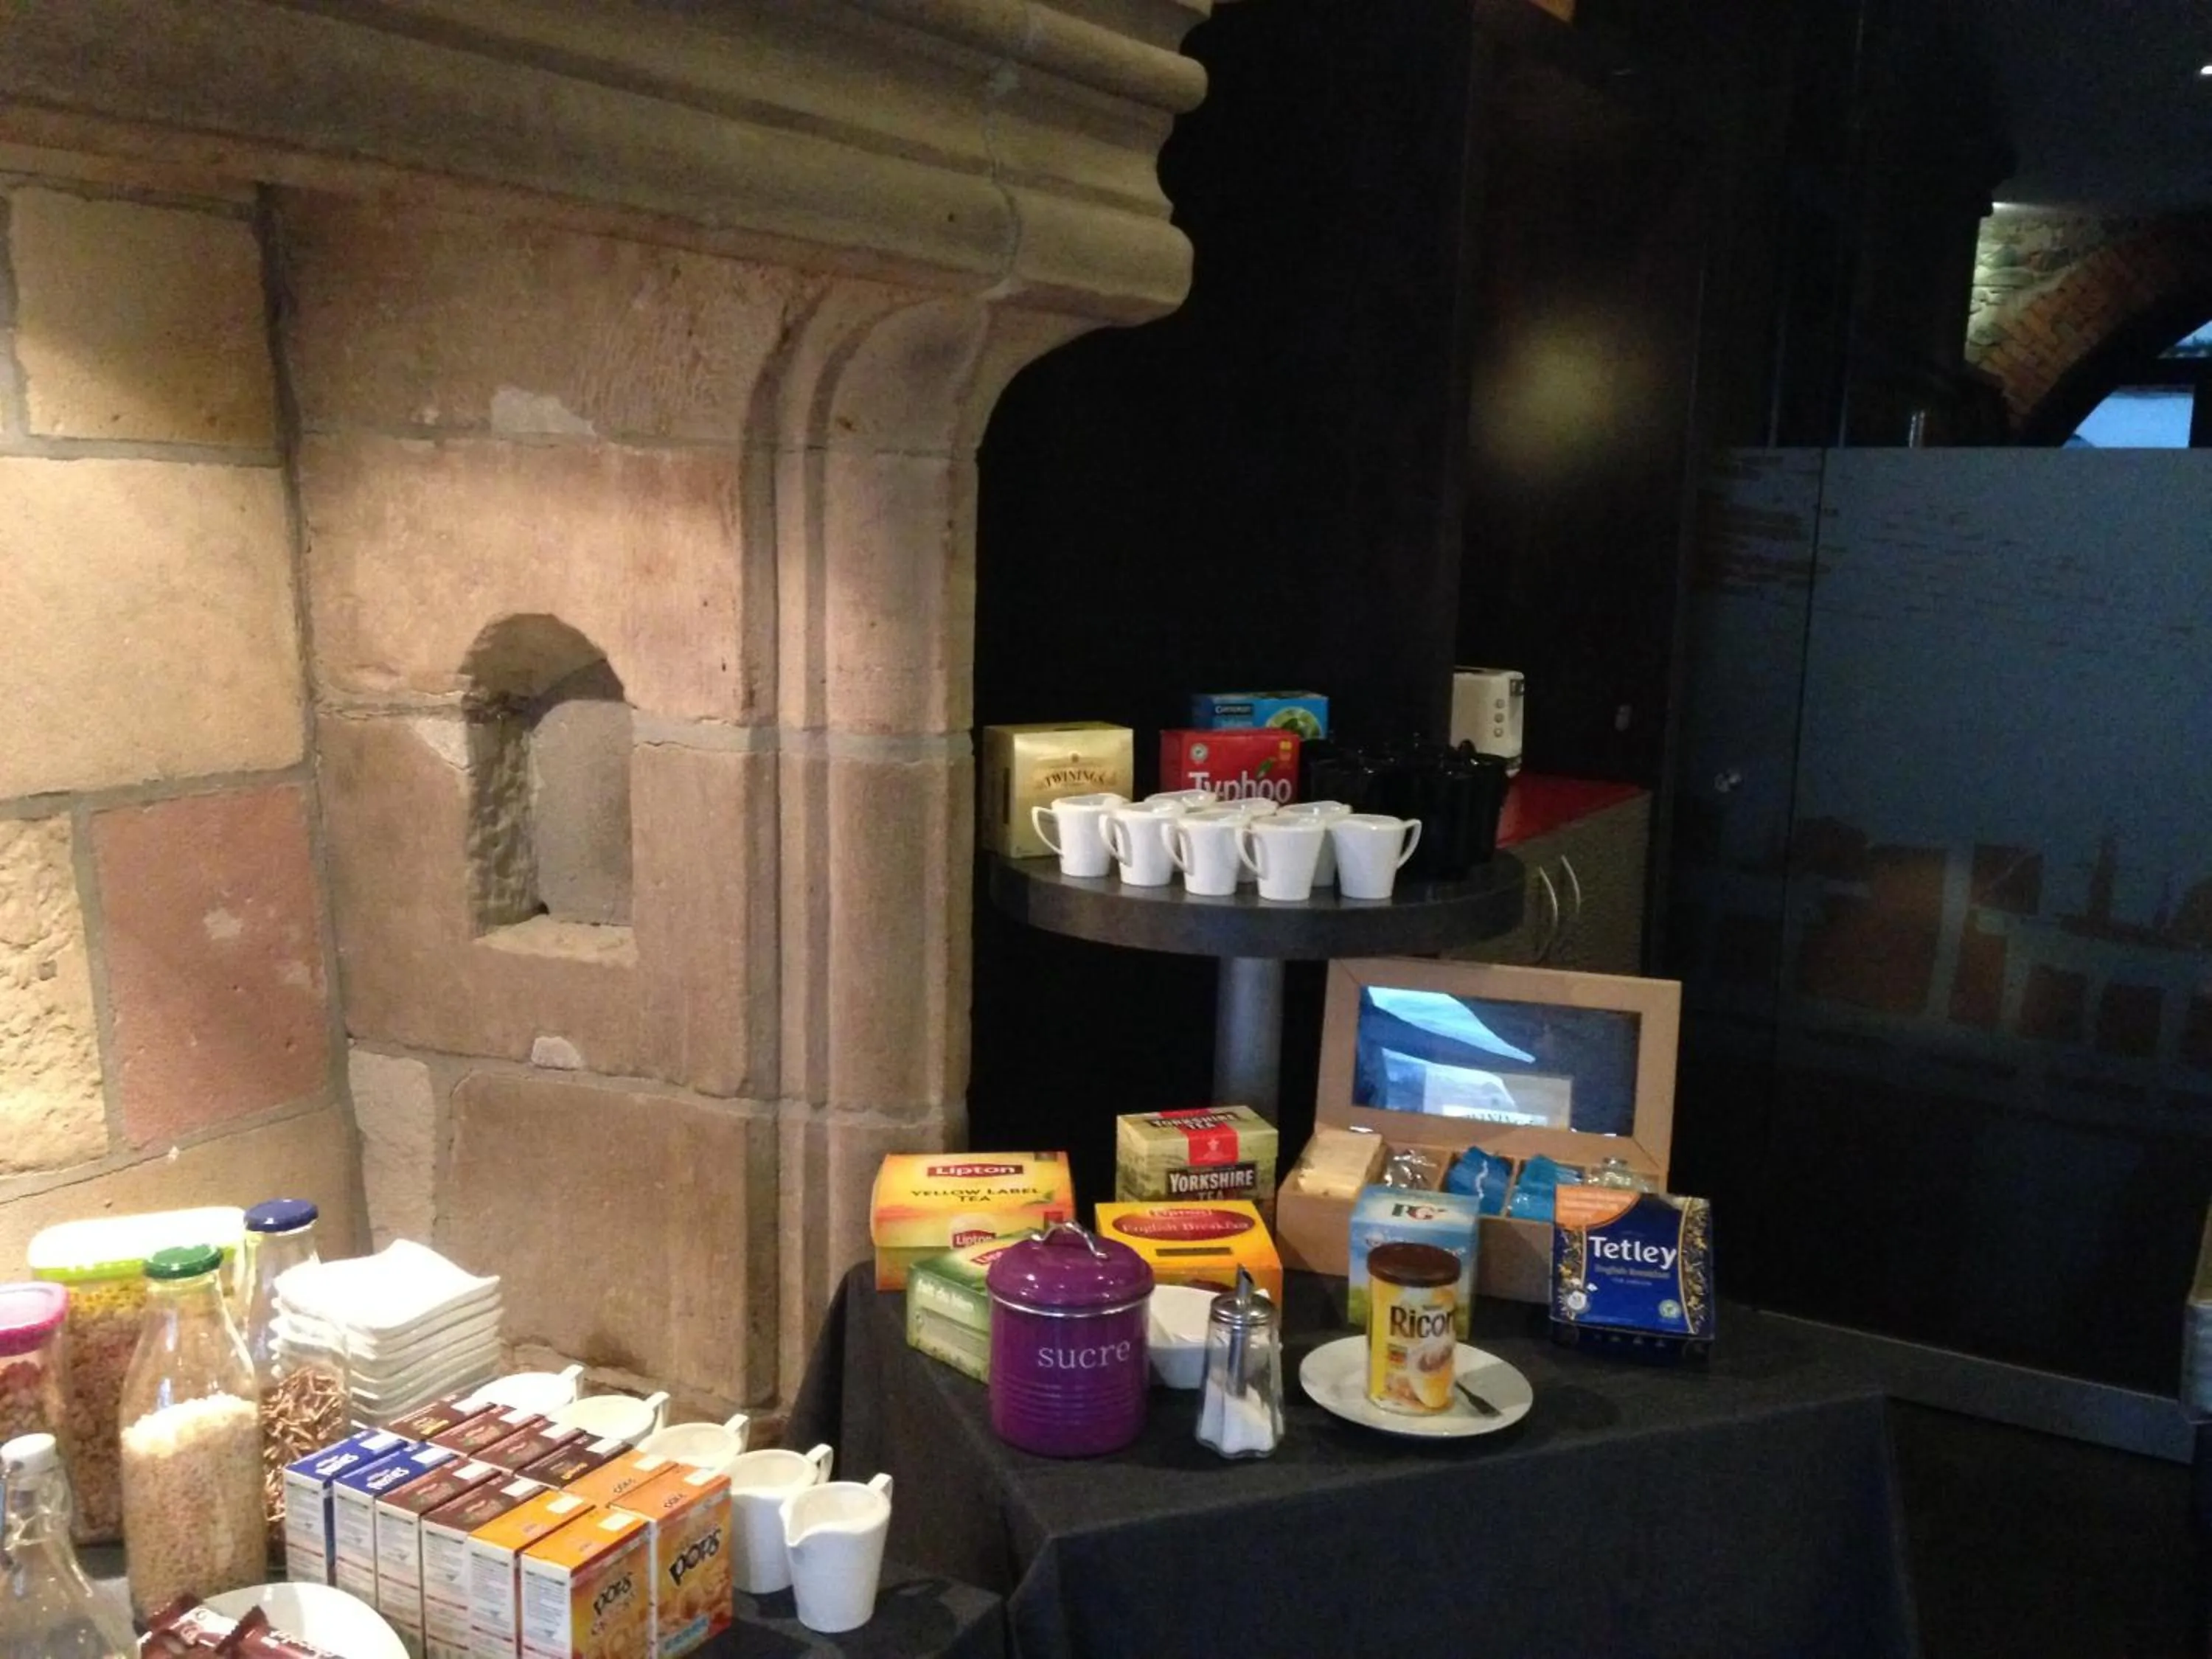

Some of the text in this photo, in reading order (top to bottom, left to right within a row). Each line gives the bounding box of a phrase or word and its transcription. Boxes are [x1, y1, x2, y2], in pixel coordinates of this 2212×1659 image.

[936, 1166, 1015, 1176] Lipton
[1169, 1169, 1254, 1192] YORKSHIRE
[911, 1188, 1040, 1197] YELLOW LABEL
[959, 1194, 991, 1203] TEA
[1197, 1189, 1225, 1201] TEA
[1587, 1236, 1677, 1270] Tetley
[1037, 1340, 1131, 1370] sucre
